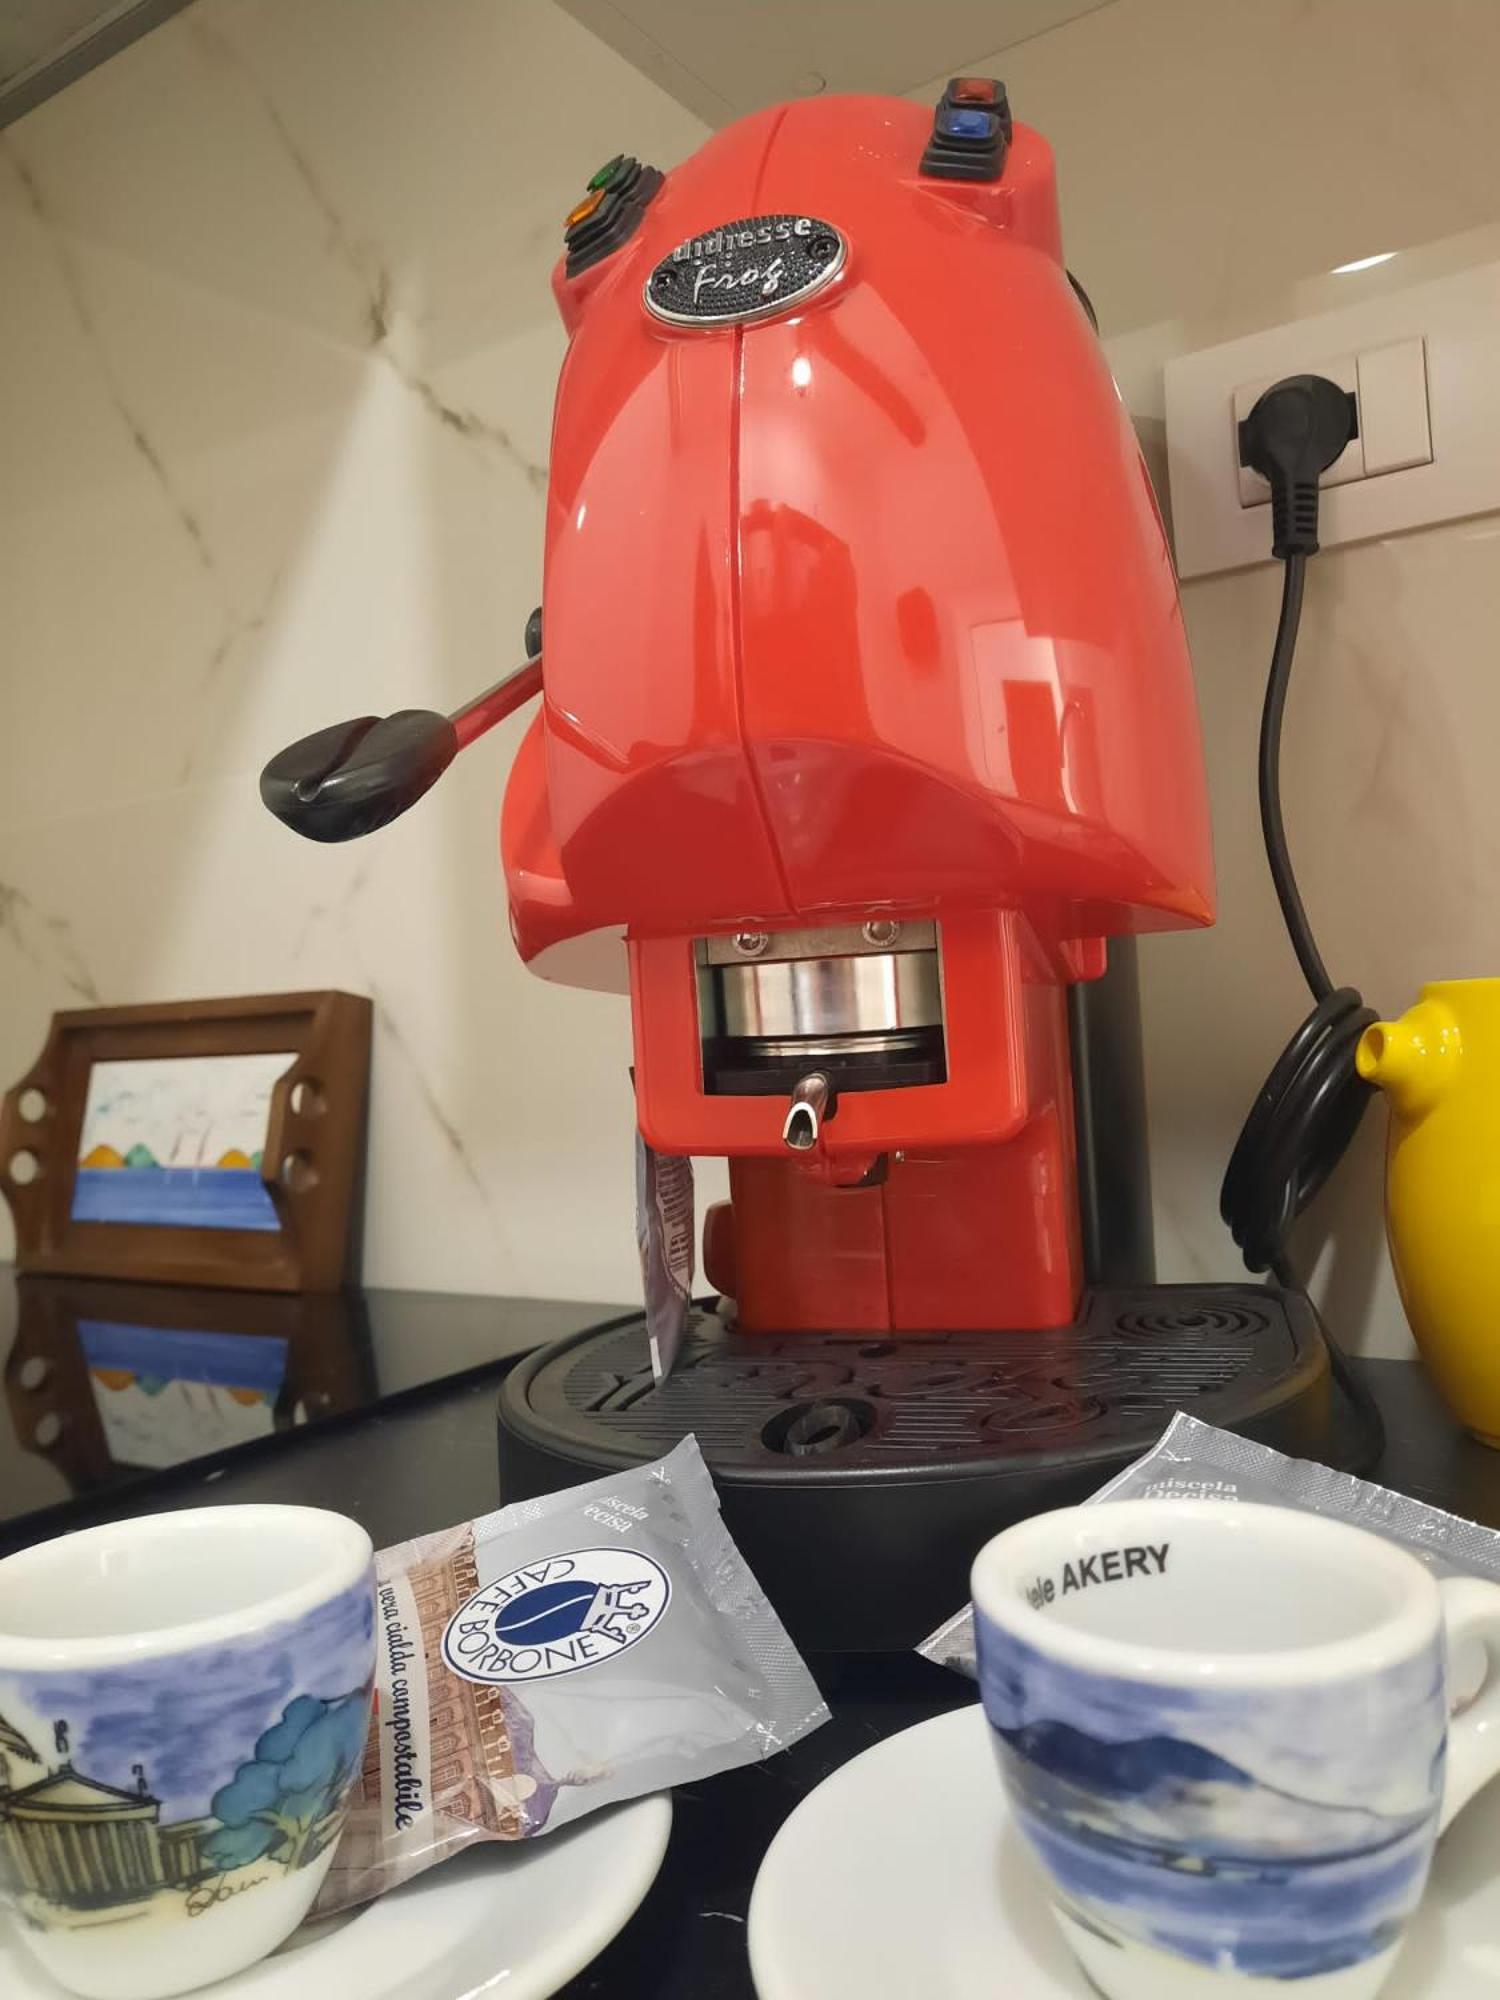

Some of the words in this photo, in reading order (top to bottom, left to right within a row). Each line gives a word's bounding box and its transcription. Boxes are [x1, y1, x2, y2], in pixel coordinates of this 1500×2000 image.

[1062, 1543, 1170, 1596] AKERY
[378, 1587, 399, 1621] vera
[386, 1622, 416, 1676] cialda
[457, 1619, 599, 1673] BORBONE
[384, 1679, 424, 1831] compostabile
